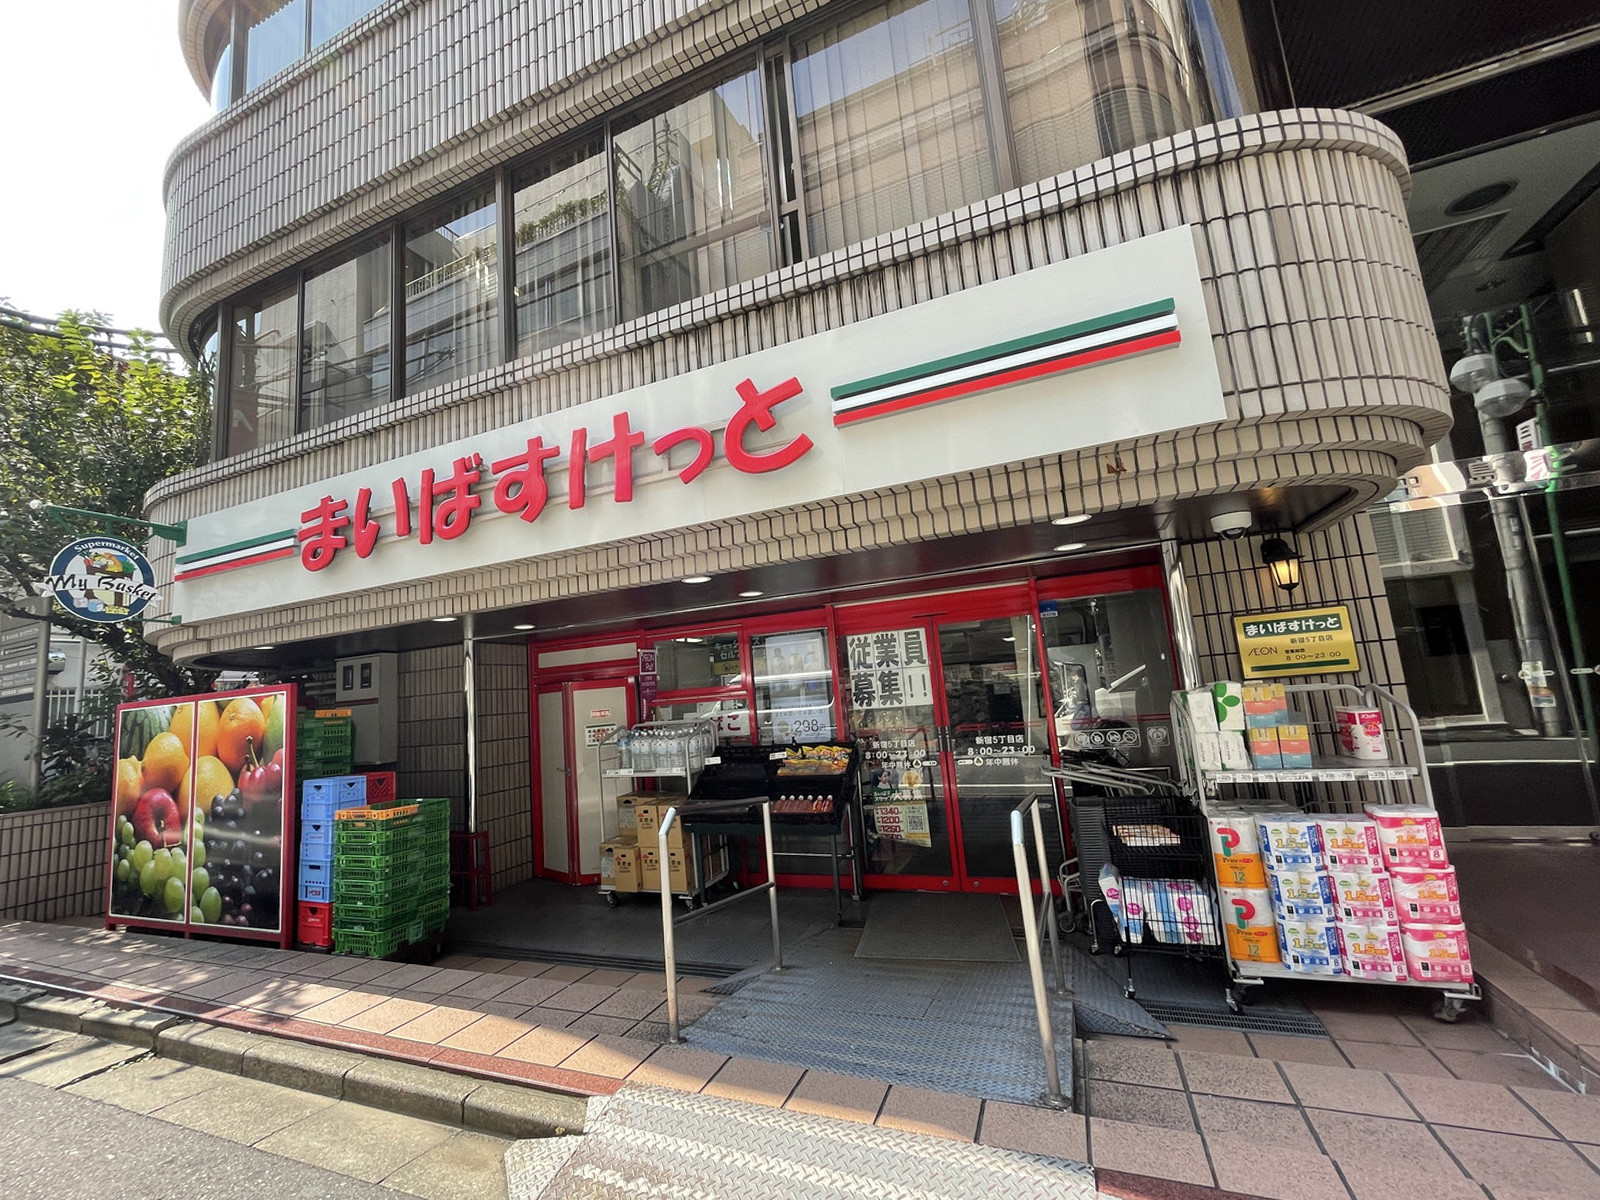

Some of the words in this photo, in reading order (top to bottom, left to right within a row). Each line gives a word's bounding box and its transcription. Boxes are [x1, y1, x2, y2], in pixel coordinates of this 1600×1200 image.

[298, 375, 815, 572] まいばすけっと
[73, 540, 141, 561] Supermarket
[45, 573, 88, 592] My
[97, 575, 157, 601] Basket
[1245, 616, 1341, 637] まいばすけっと
[1289, 634, 1334, 645] 新宿5丁目店
[849, 630, 927, 671] 従業員
[872, 739, 916, 749] 新宿5丁目店
[975, 735, 1024, 745] 新宿5丁目店
[892, 789, 923, 801] 大募集
[1233, 871, 1246, 882] 12
